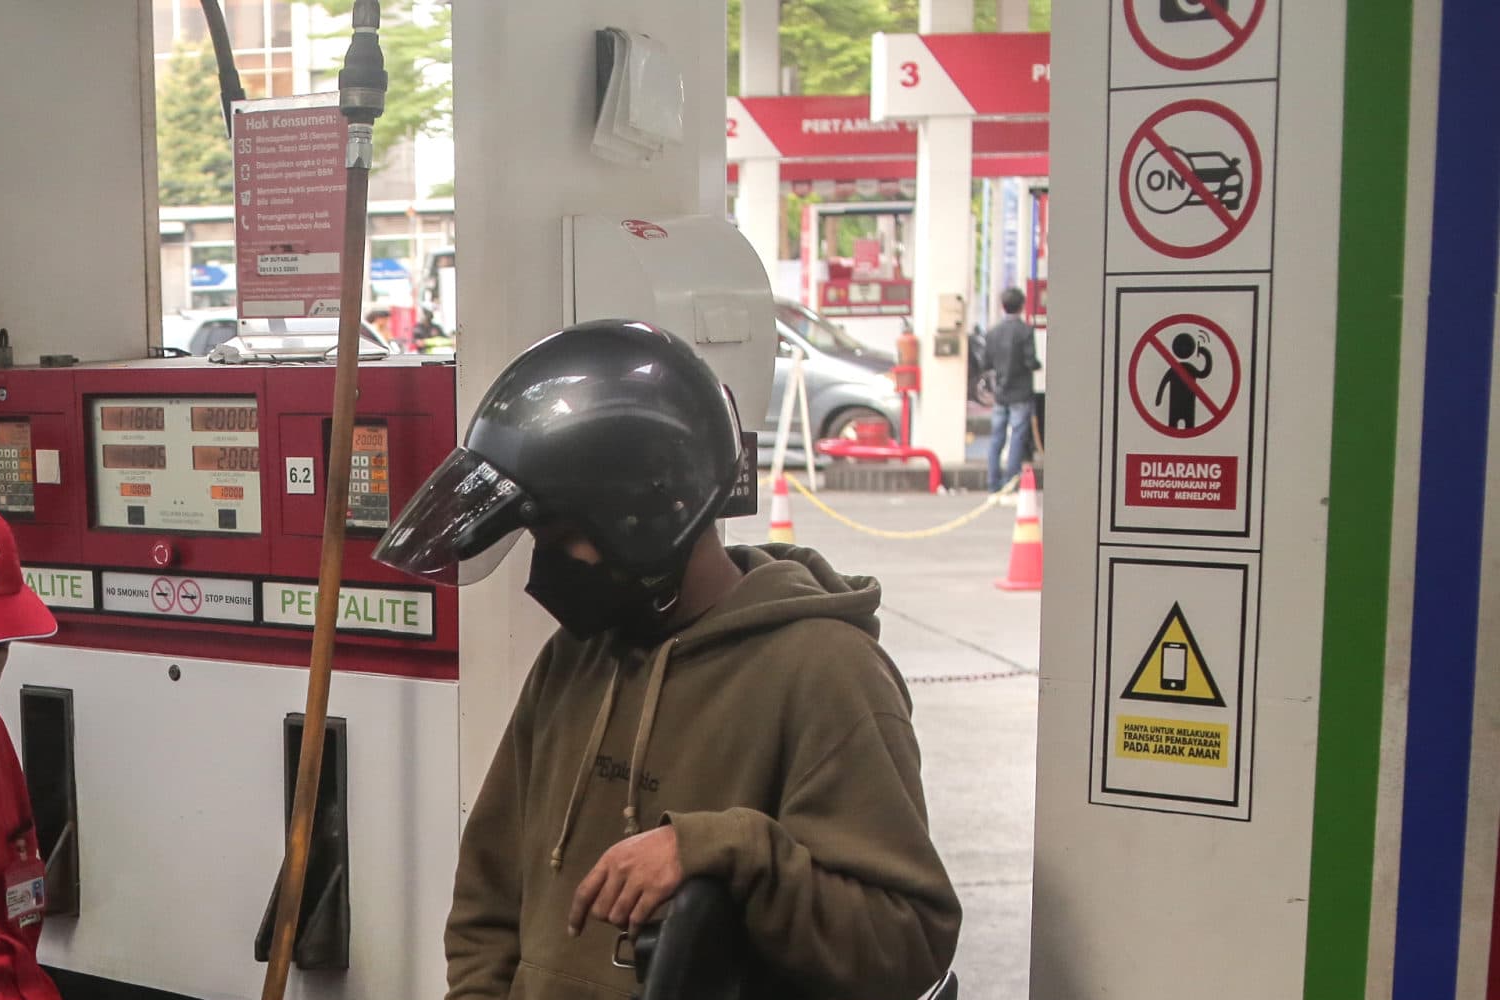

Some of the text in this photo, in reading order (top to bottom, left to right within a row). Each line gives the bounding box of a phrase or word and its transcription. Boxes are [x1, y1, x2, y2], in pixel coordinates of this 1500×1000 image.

[900, 61, 919, 88] 3
[272, 115, 337, 129] Konsumen:
[726, 118, 738, 138] 2
[1147, 169, 1185, 192] ON
[289, 467, 311, 484] 6.2
[1141, 462, 1222, 479] DILARANG
[1141, 479, 1221, 490] MENGGUNAKAN HP
[1141, 490, 1220, 501] UNTUK MENELPON
[106, 587, 149, 598] NO SMOKING
[205, 593, 252, 606] STOP ENGINE
[281, 589, 419, 626] PEALITE
[1124, 723, 1220, 739] HANYA UNTUK MELAKUKAN
[1165, 736, 1220, 748] PEMBAYARAN
[1123, 741, 1220, 760] PADA JARAK AMAN
